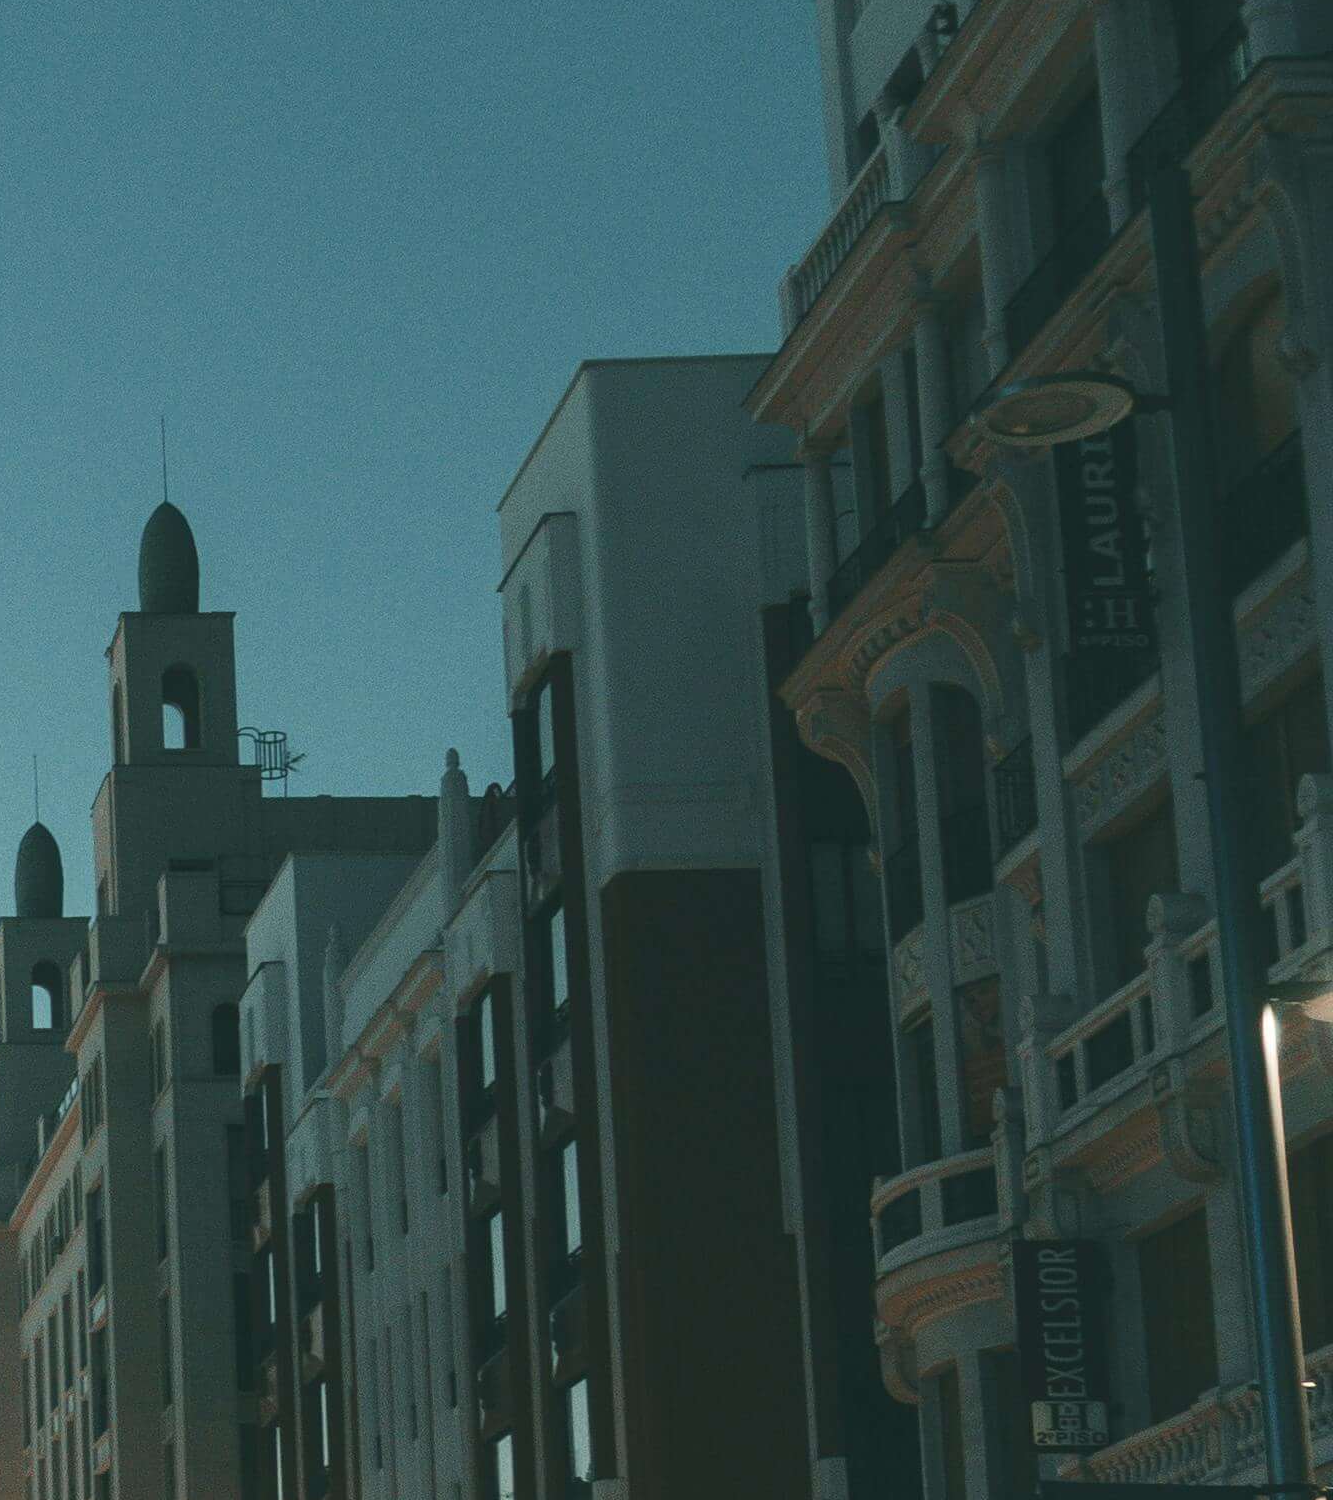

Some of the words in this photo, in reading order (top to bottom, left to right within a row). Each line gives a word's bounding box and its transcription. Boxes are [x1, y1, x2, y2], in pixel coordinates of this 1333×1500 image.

[1080, 431, 1127, 588] LAURI
[1036, 1246, 1088, 1399] EXCELSIOR
[1057, 1430, 1109, 1446] PISO
